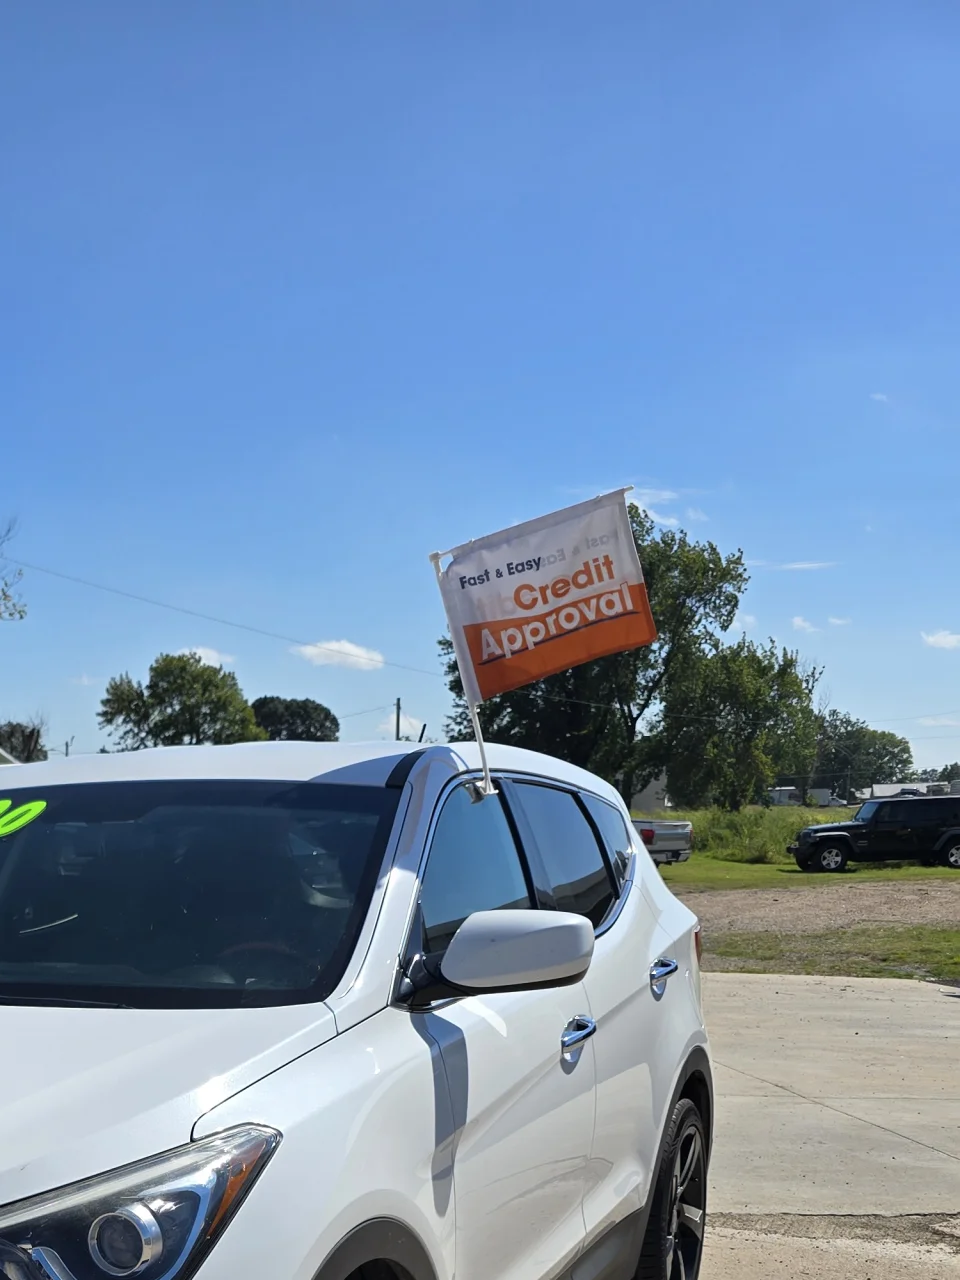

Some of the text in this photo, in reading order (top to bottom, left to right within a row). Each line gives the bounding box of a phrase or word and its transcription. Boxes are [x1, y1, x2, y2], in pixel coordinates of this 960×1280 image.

[459, 557, 541, 590] Fast & Easy
[514, 554, 616, 611] Credit
[481, 581, 634, 661] Approval
